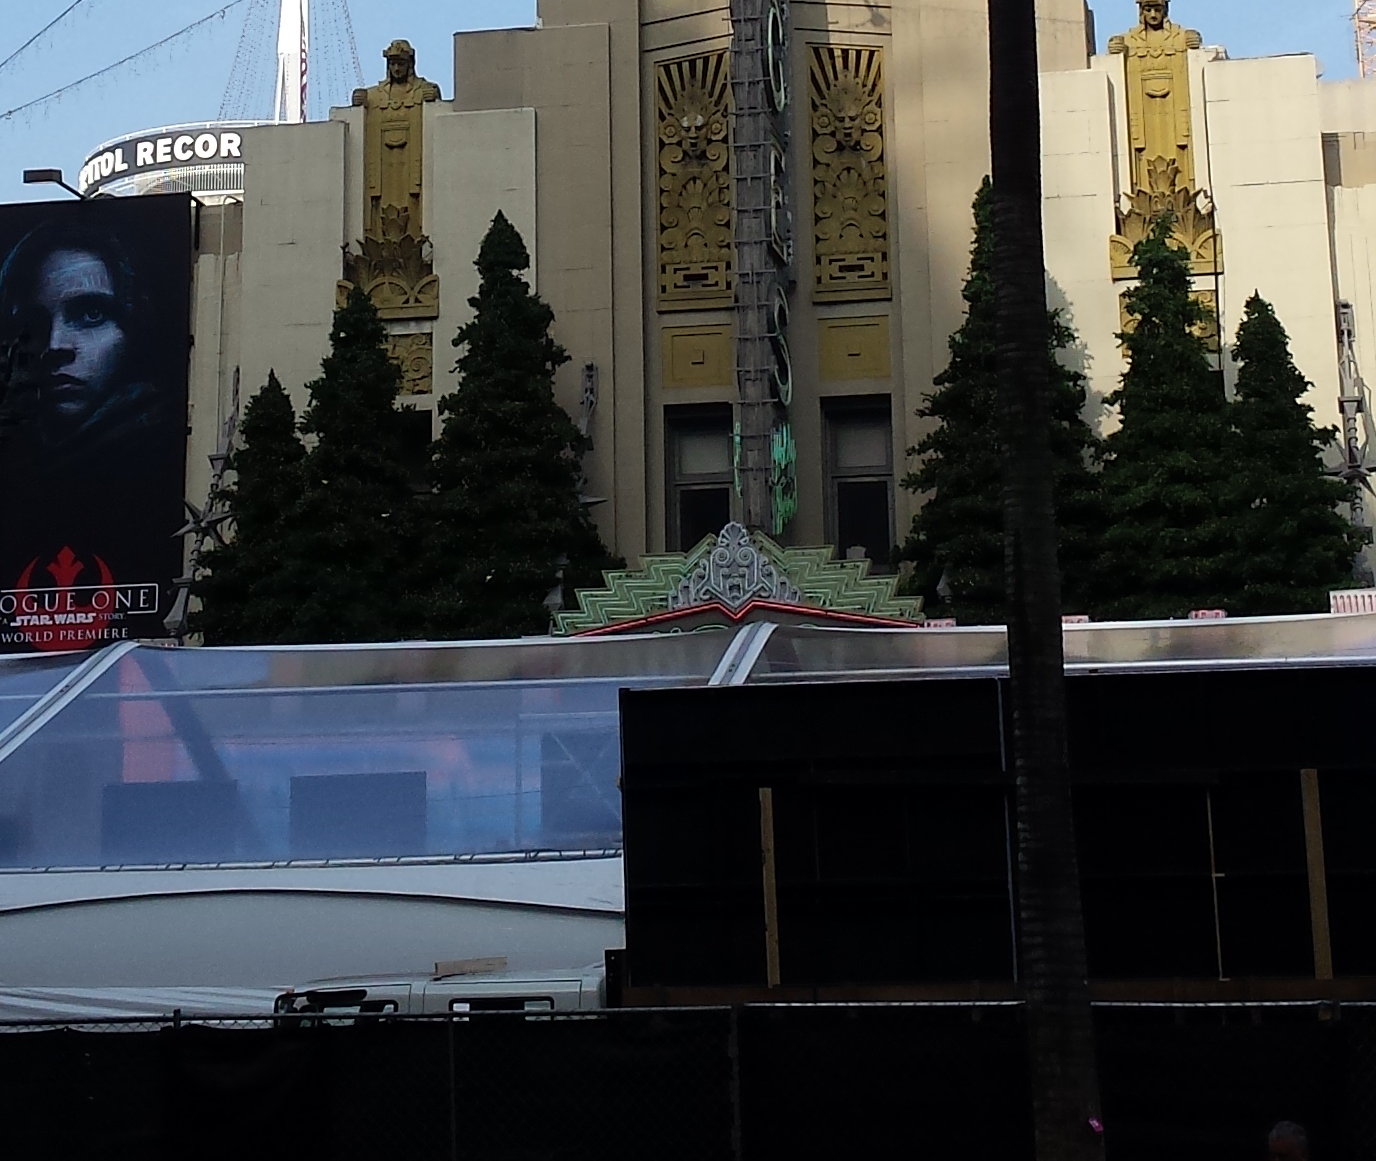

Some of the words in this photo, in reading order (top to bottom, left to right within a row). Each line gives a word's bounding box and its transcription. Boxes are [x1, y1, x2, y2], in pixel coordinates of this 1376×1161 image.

[91, 588, 151, 611] ONE
[10, 614, 52, 627] STAR
[53, 612, 97, 625] WARS
[98, 612, 124, 621] STORY
[1, 630, 53, 644] WORLD
[59, 627, 129, 641] PREMIERE
